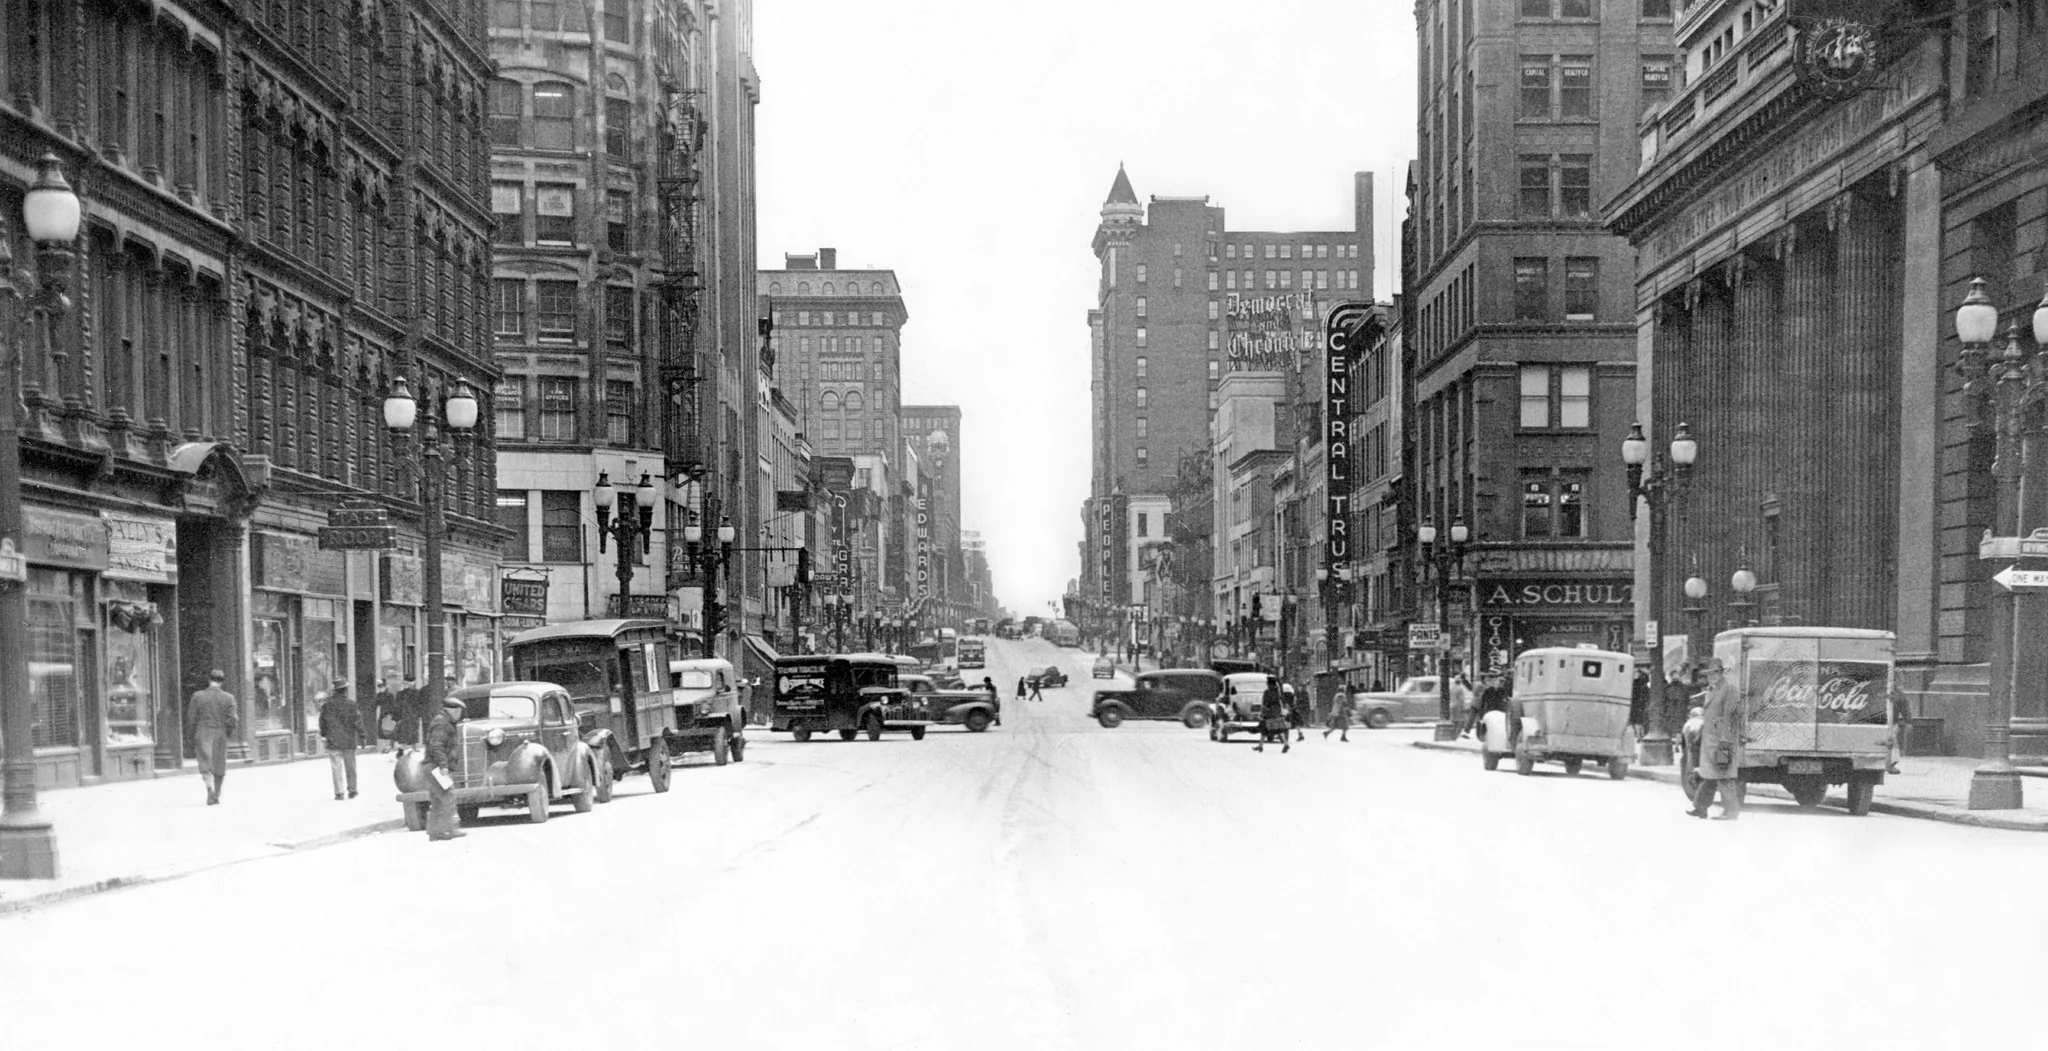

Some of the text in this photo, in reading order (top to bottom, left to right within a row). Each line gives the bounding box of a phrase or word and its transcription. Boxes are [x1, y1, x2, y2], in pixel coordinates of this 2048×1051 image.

[1525, 68, 1545, 77] CAPITAL
[1226, 284, 1314, 316] Democrat
[1329, 332, 1347, 480] CENTRAL
[917, 498, 928, 596] EDWARDS
[1330, 495, 1347, 594] TRUST
[504, 582, 545, 598] UNITED
[504, 597, 545, 612] CIGARS
[1489, 617, 1503, 675] CIGARS
